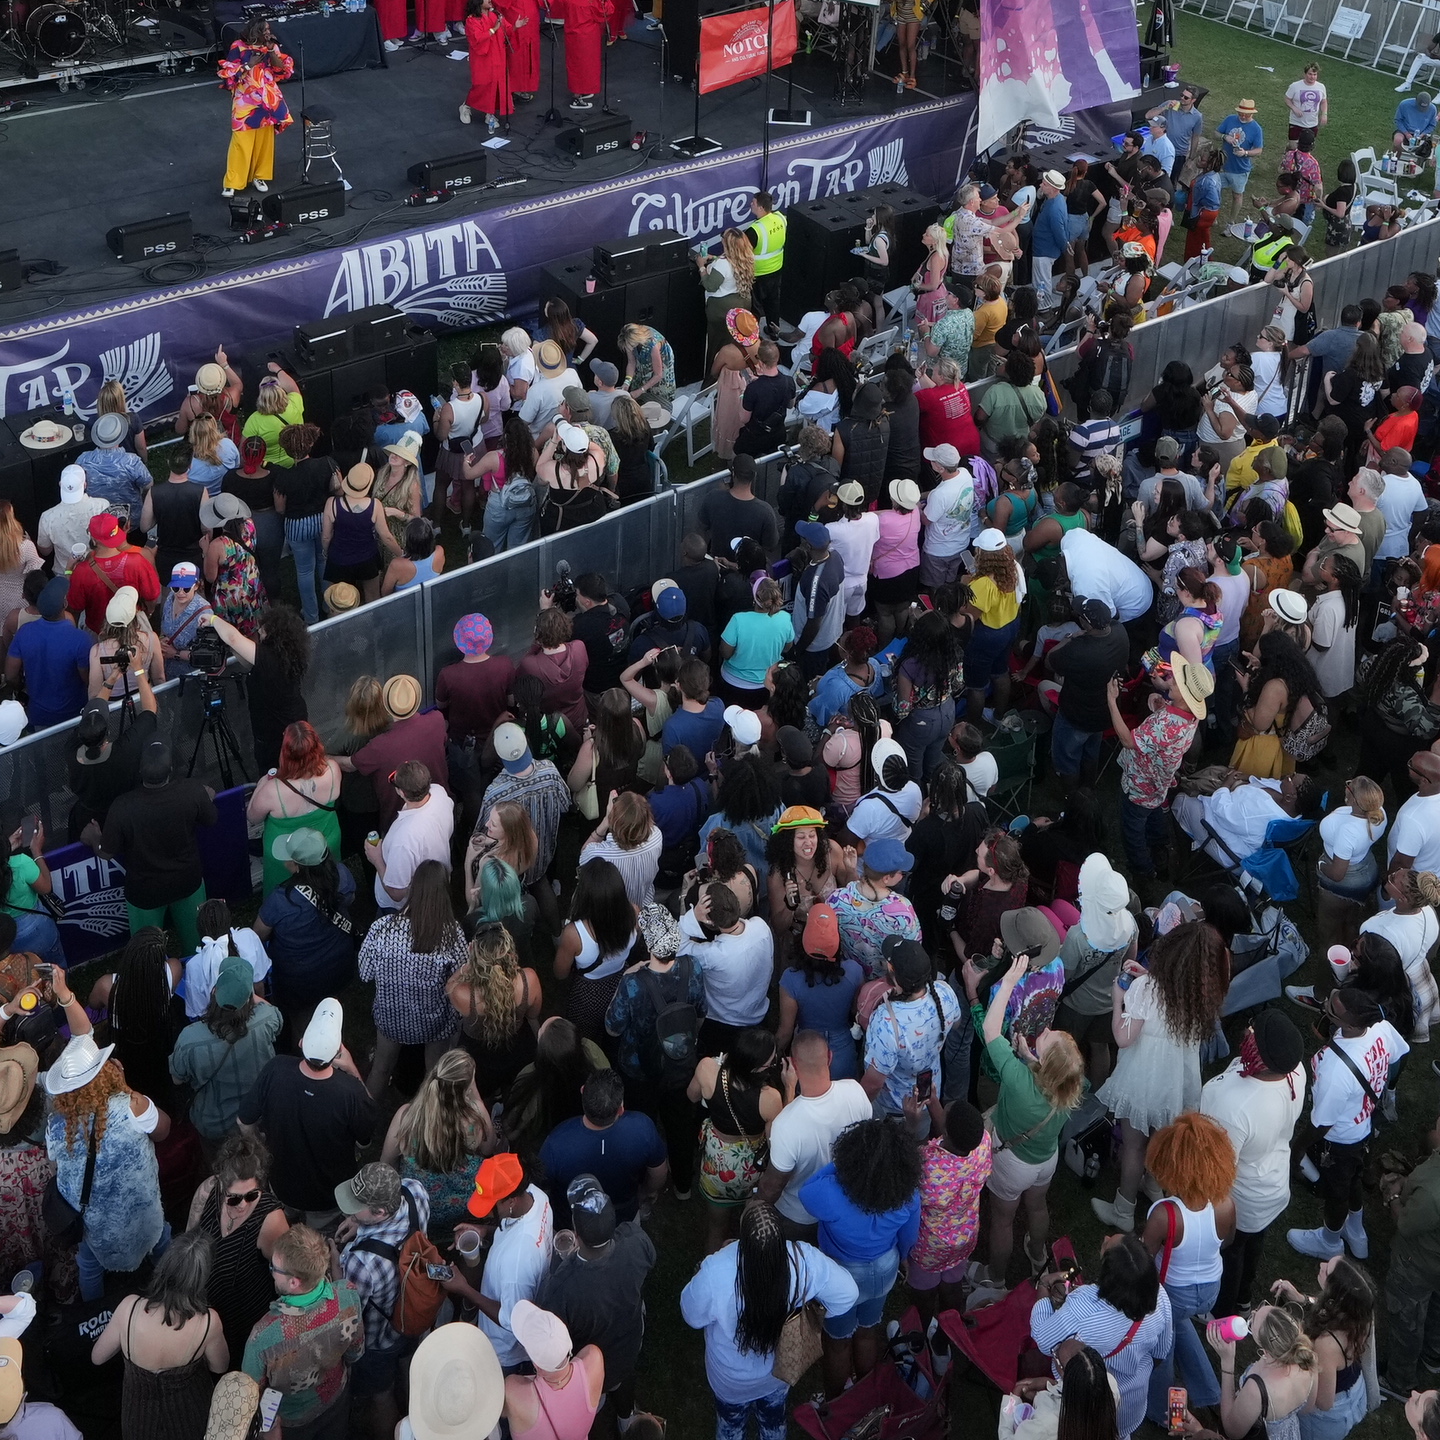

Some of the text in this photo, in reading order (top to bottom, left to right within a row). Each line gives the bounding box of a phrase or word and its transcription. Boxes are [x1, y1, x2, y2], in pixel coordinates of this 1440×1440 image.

[595, 139, 618, 153] PSS
[445, 175, 472, 189] PSS
[298, 208, 329, 223] PSS
[627, 185, 761, 240] Culture
[771, 179, 801, 210] on
[143, 240, 177, 257] PSS
[323, 221, 502, 319] ABITA
[50, 855, 127, 902] ITA
